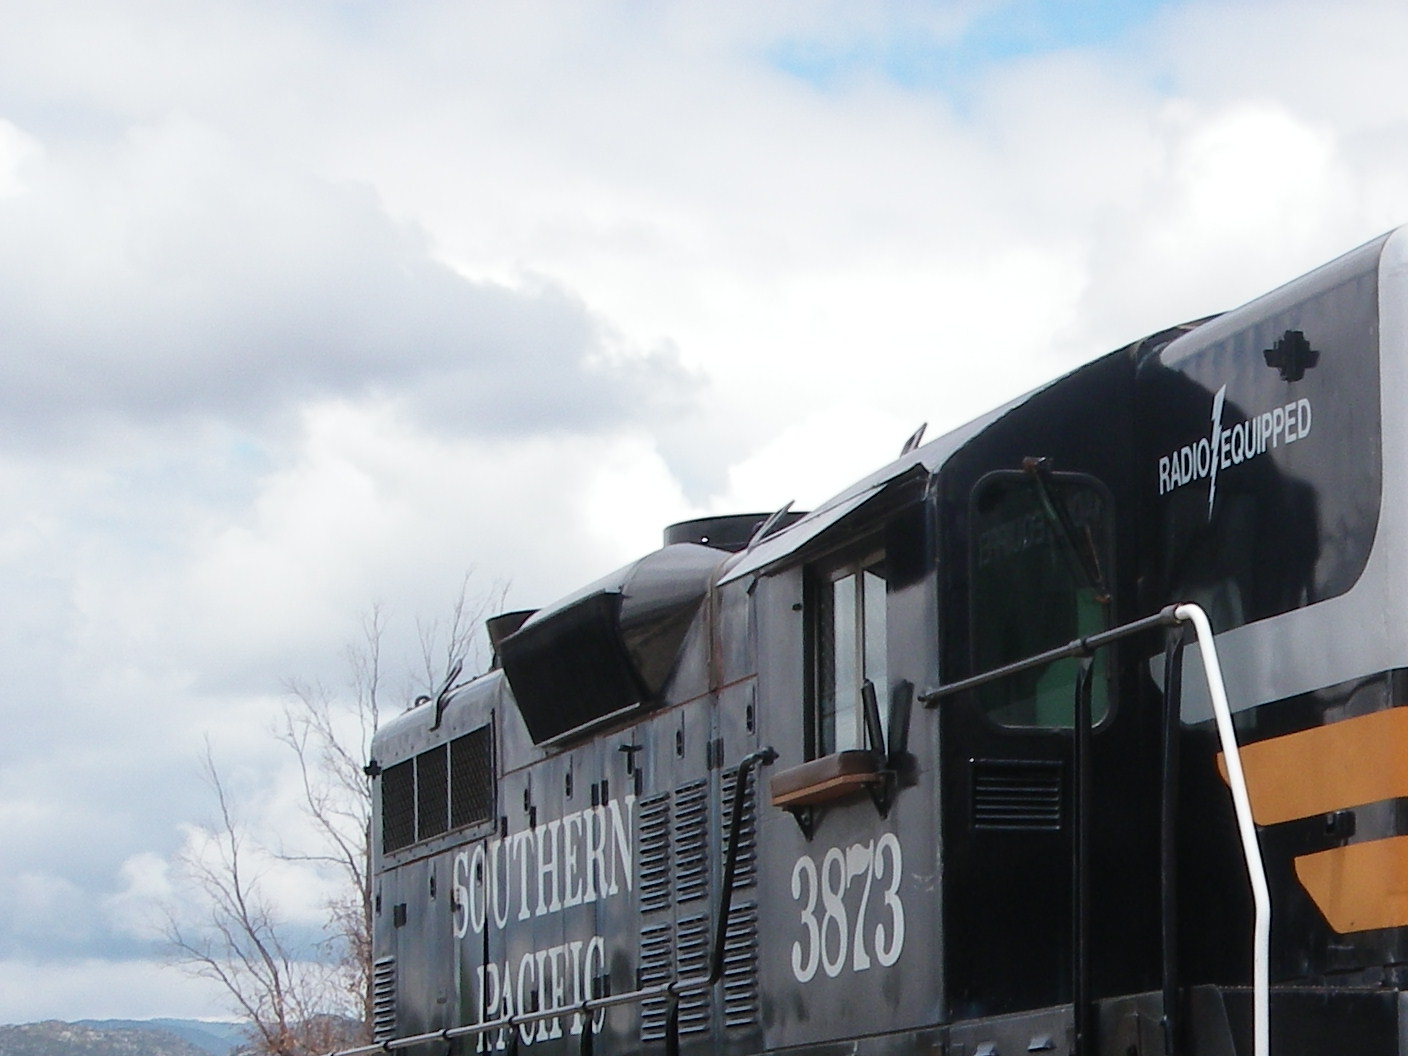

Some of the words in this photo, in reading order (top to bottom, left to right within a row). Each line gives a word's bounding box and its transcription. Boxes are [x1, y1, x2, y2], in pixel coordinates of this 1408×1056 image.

[1158, 437, 1212, 496] RADIO
[1220, 398, 1312, 471] EQUIPPED
[451, 794, 638, 940] SOUTHERN
[790, 832, 905, 984] 3873
[475, 935, 607, 1054] PACIFIC
